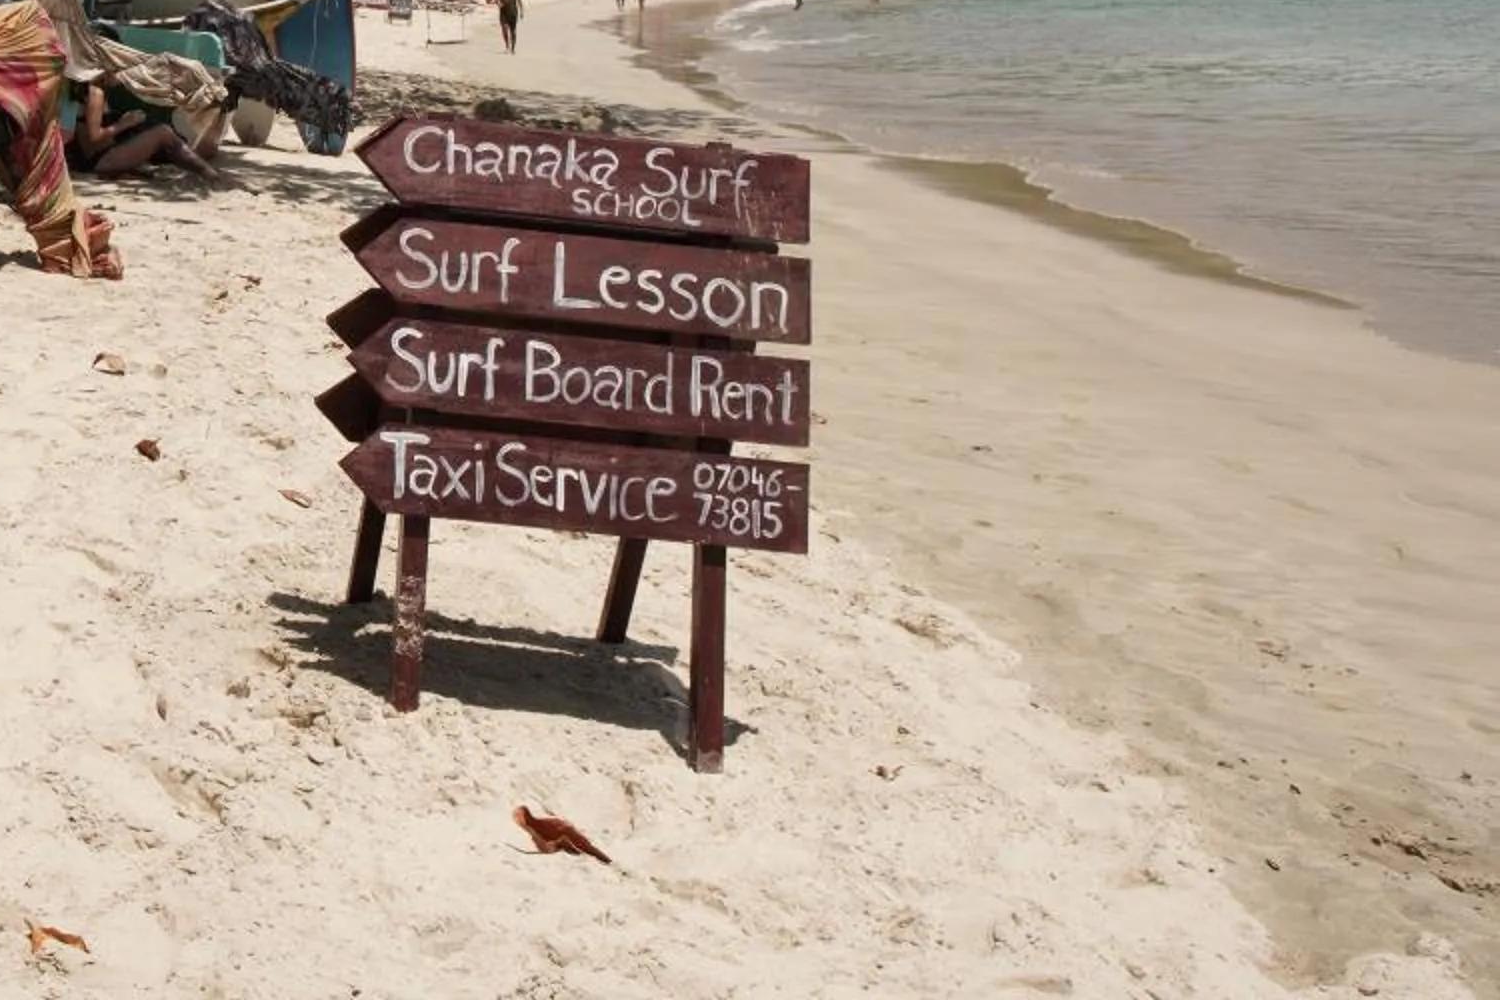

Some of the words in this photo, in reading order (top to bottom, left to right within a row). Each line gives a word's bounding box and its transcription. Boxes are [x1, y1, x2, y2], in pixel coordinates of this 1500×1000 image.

[403, 125, 619, 191] Chanaka
[641, 146, 758, 218] Surf
[571, 188, 702, 227] SCHOOL
[396, 226, 521, 305] Surf
[552, 241, 789, 335] Lesson
[385, 327, 504, 400] Surf
[524, 339, 674, 416] Board
[690, 354, 798, 426] Rent
[380, 431, 486, 503] Taxi
[495, 442, 679, 523] Service
[693, 491, 783, 539] 73815
